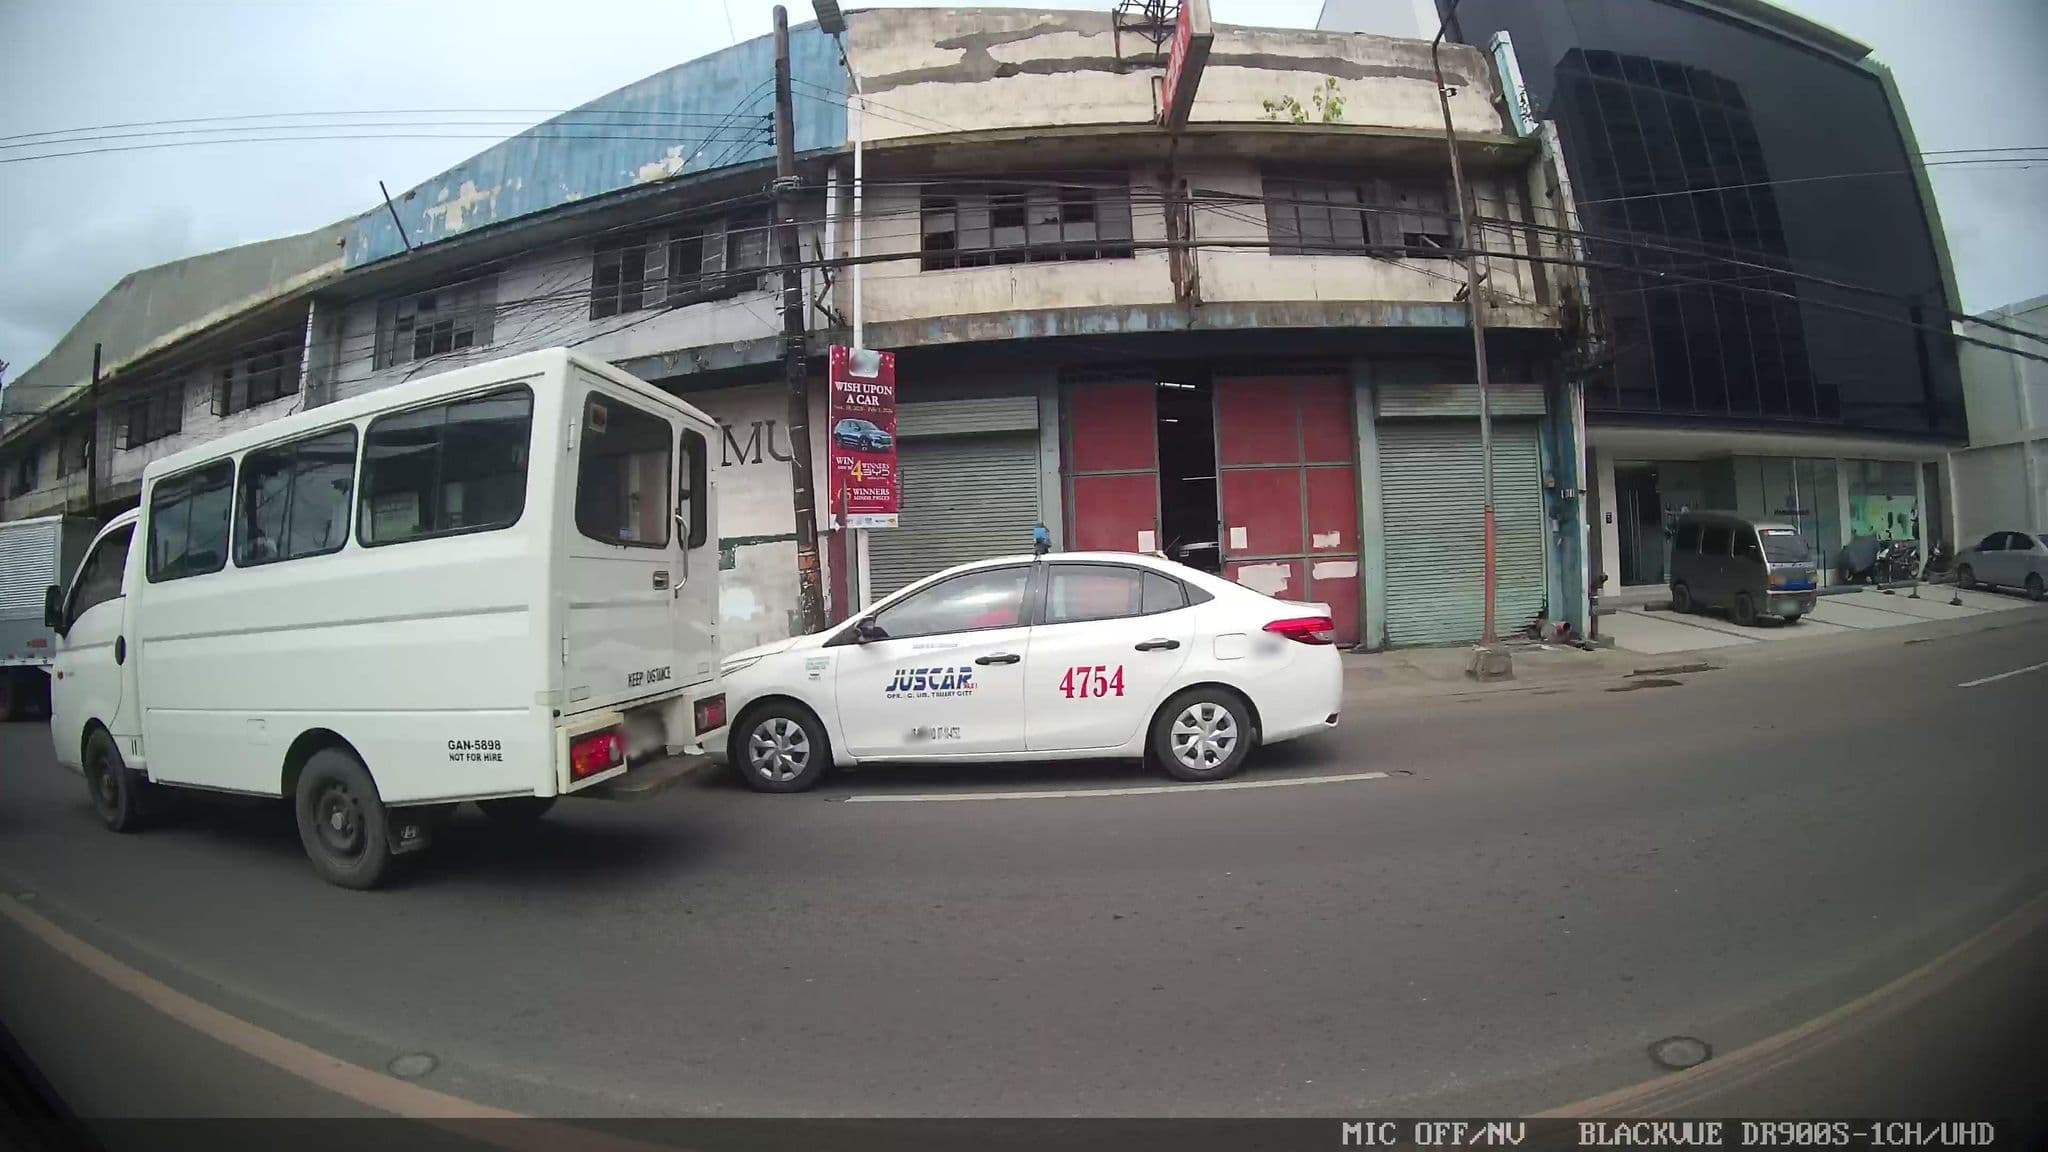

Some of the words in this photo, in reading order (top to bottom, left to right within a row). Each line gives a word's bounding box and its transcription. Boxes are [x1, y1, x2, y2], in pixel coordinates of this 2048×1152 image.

[834, 381, 862, 393] WISH
[862, 383, 893, 396] UPON
[846, 393, 855, 404] A
[856, 394, 880, 407] CAR
[835, 456, 854, 465] WIN
[850, 460, 864, 482] 4
[852, 488, 890, 496] WINNERS
[628, 671, 644, 688] KEEP
[885, 666, 973, 692] JUSCAR
[1059, 665, 1125, 699] 4754
[448, 739, 502, 750] GAN-5898
[449, 753, 464, 761] NOT
[466, 753, 482, 761] FOR
[483, 753, 503, 762] HIRE
